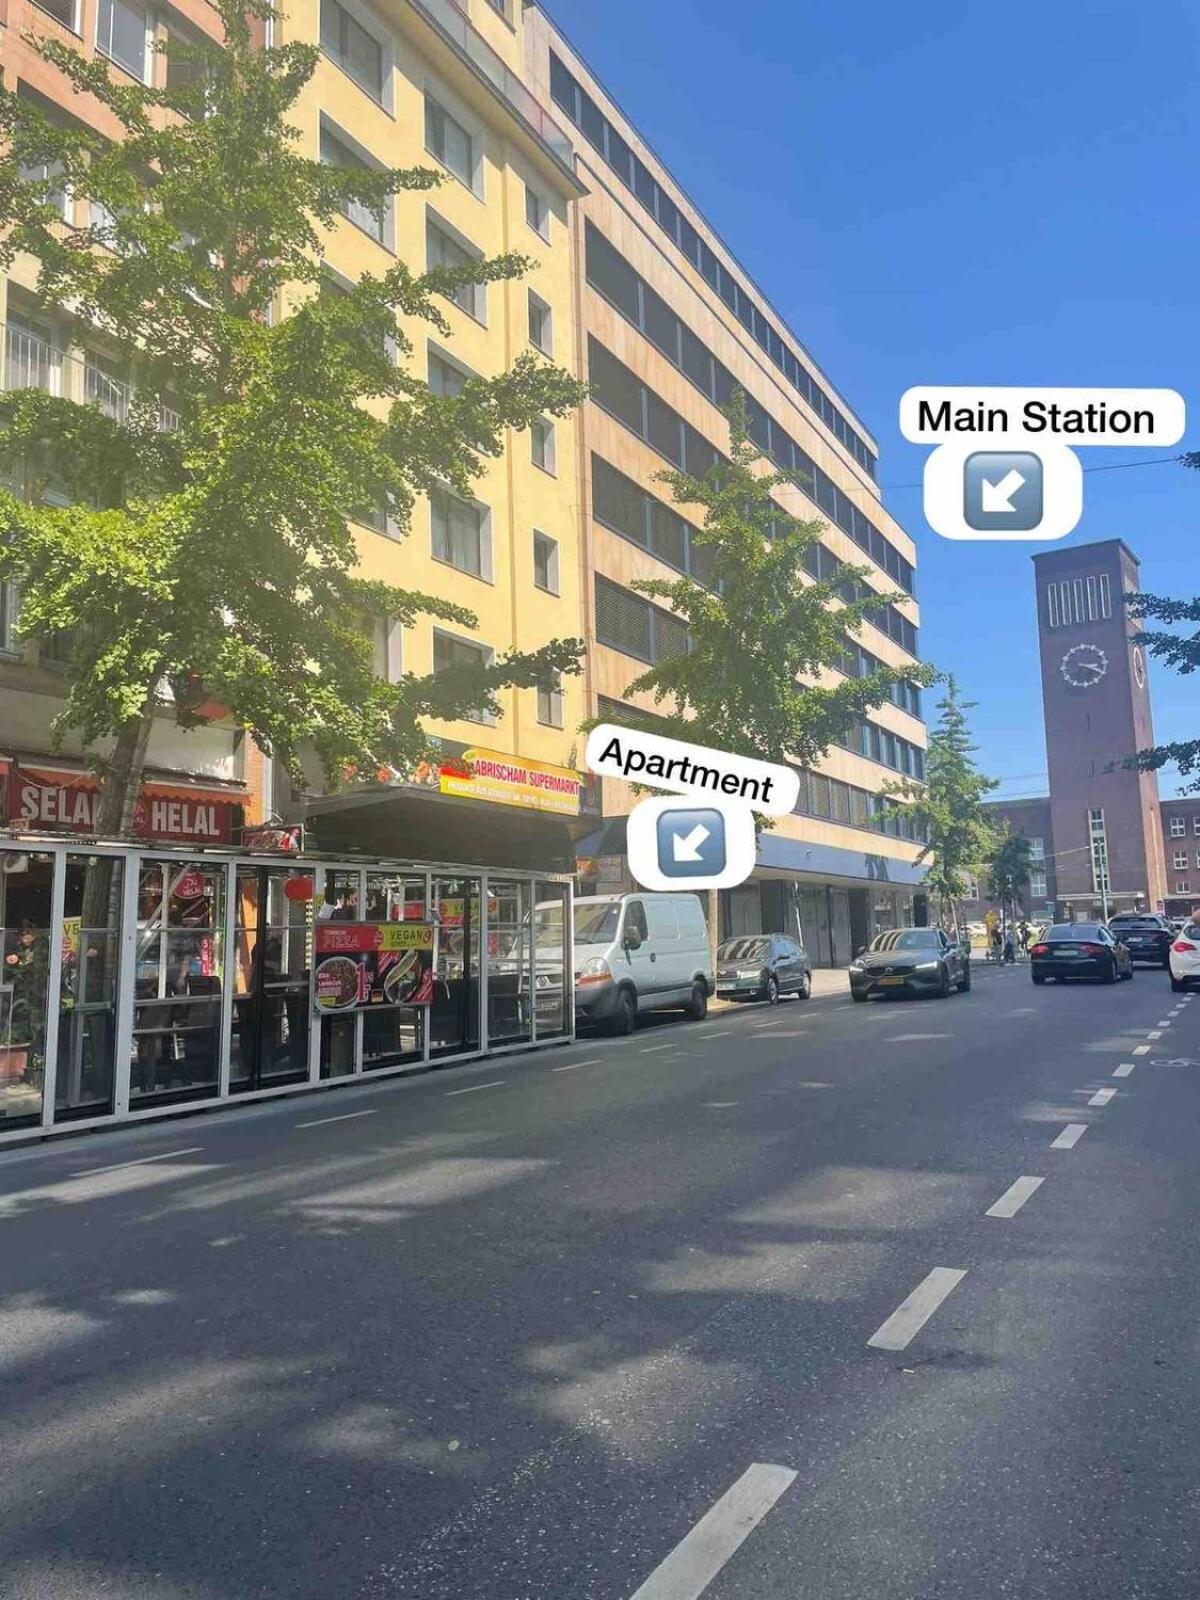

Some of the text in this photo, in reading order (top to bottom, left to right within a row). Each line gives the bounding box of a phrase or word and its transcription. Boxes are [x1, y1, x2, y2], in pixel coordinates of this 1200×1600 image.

[529, 771, 579, 795] SUPERMARKT
[152, 801, 220, 836] HELAL
[390, 929, 422, 941] VEGAN
